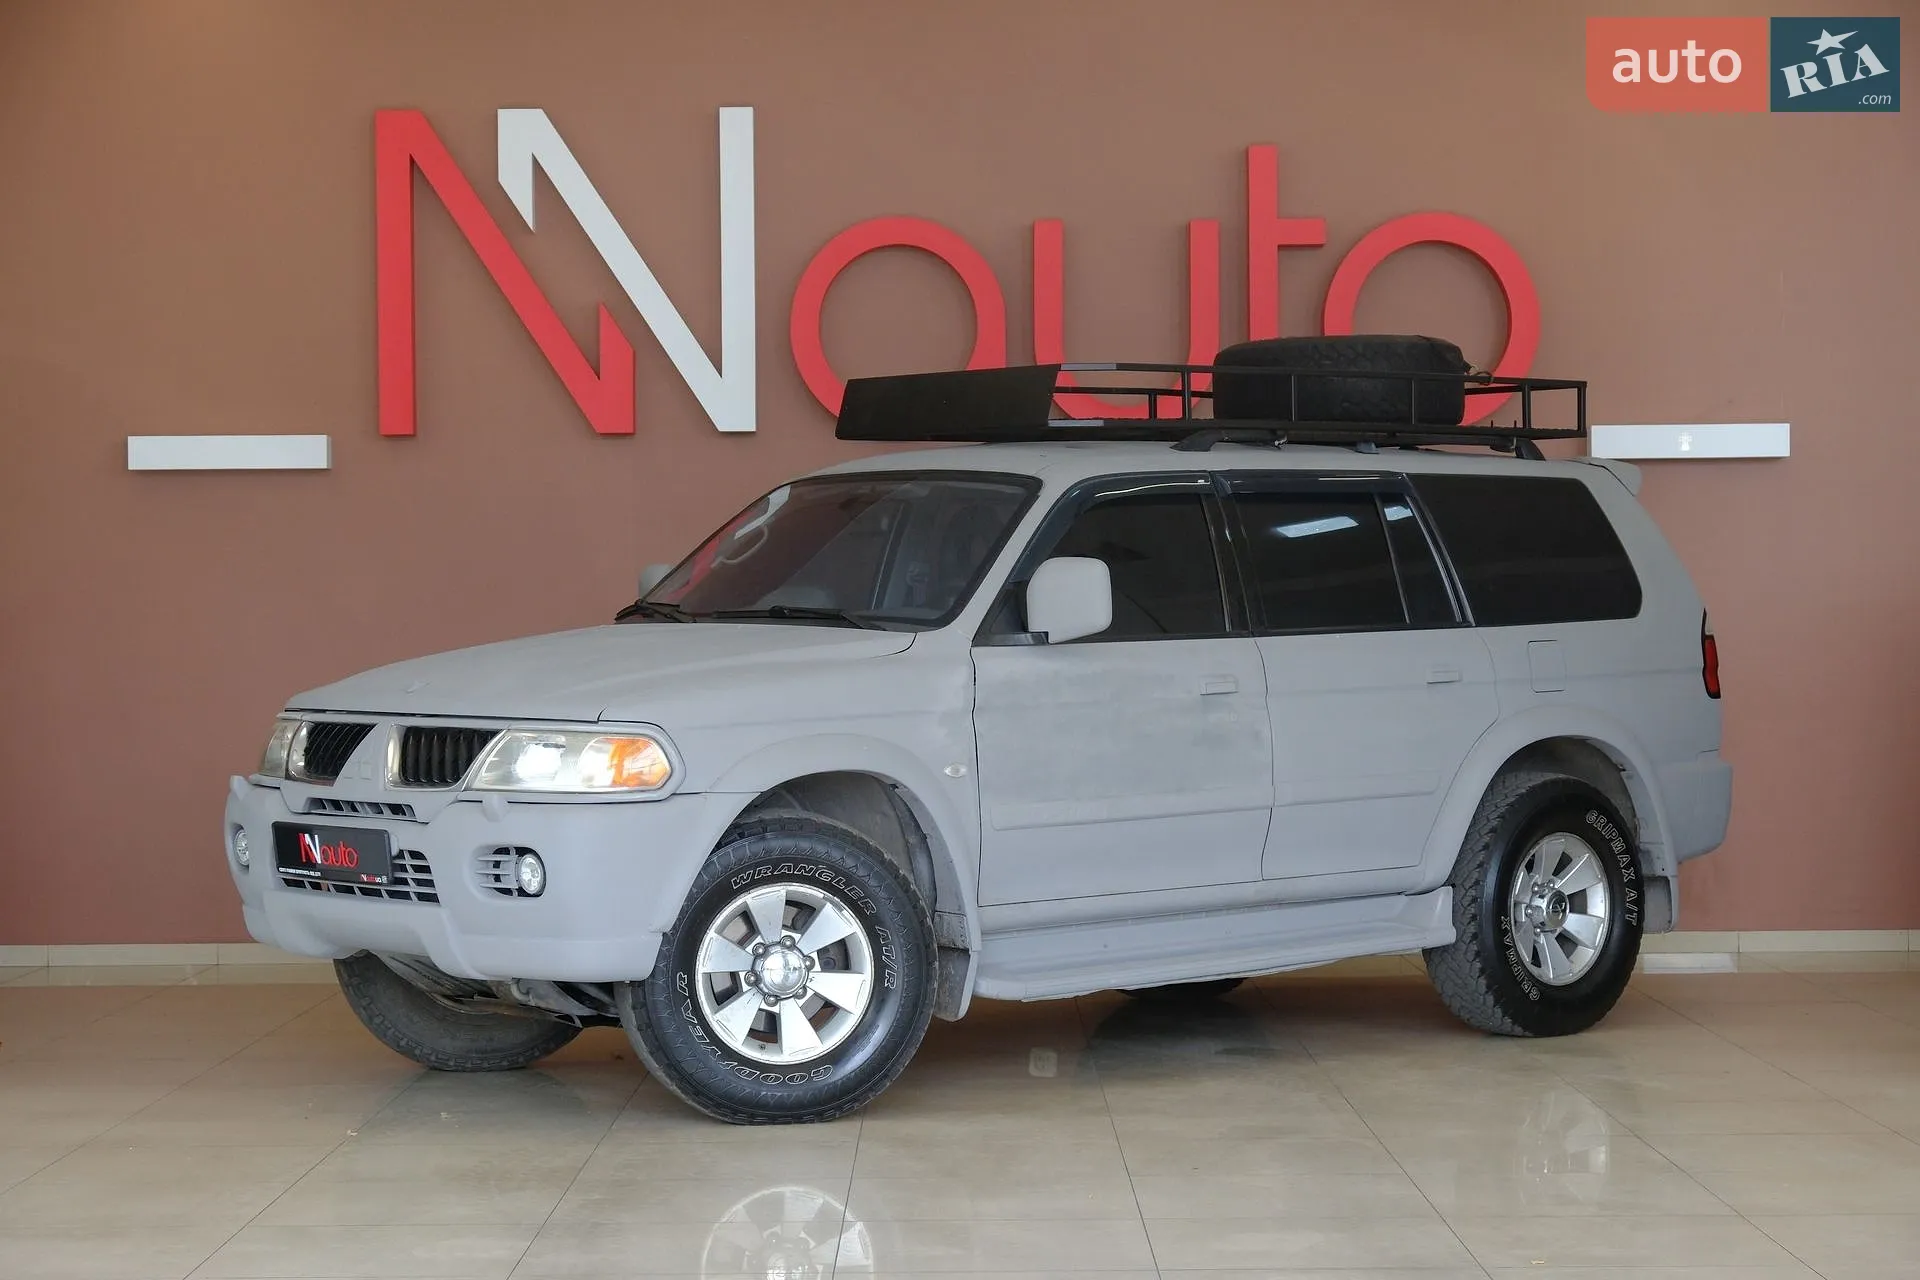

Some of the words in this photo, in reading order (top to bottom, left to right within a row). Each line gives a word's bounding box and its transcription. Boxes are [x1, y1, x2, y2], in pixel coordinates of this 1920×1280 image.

[1585, 809, 1635, 881] GRIPMAX
[1625, 887, 1639, 926] A/T
[731, 863, 877, 916] WRANGLER
[875, 926, 897, 990] AT/R
[1500, 915, 1540, 1001] GRIPMAX
[676, 971, 834, 1085] GOODYEAR
